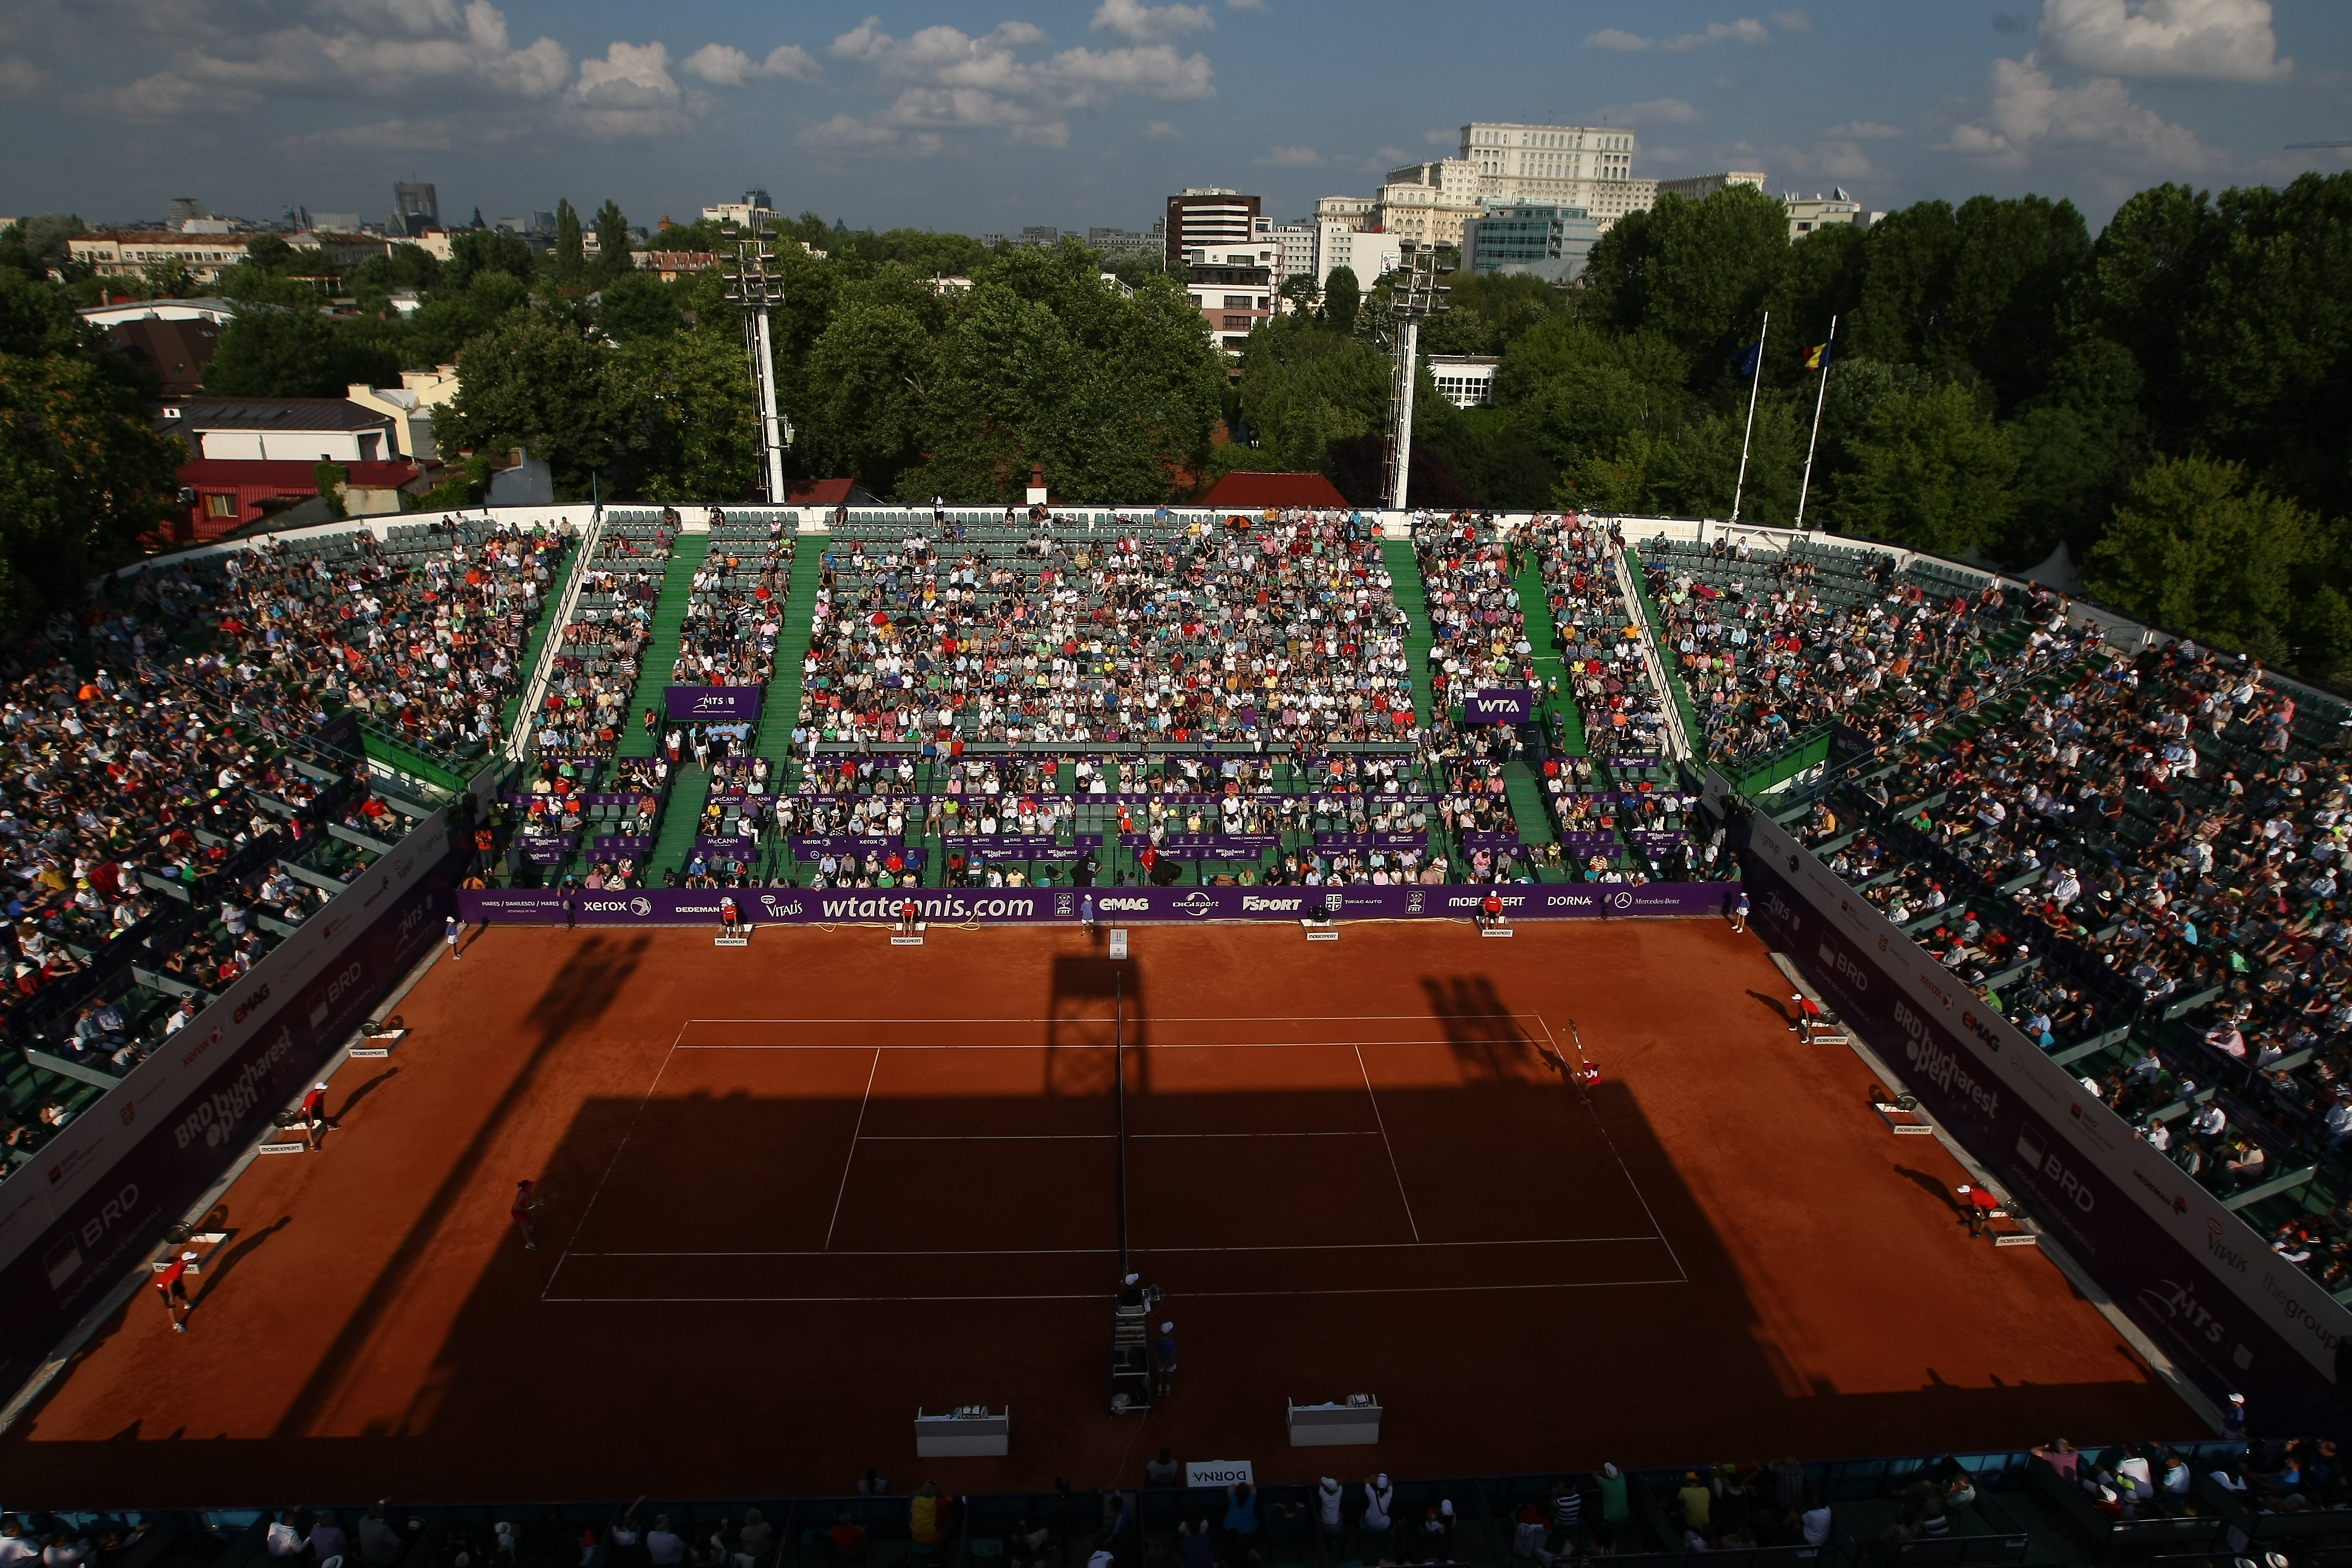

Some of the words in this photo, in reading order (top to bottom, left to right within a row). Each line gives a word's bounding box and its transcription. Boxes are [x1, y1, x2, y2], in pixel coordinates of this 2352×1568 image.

[1477, 699, 1520, 712] WTA
[584, 901, 627, 911] xerox
[1099, 898, 1149, 911] eMAG
[1250, 899, 1302, 911] SPORT
[1548, 897, 1593, 906] DORNA
[328, 962, 361, 1003] BRD
[1837, 952, 1868, 991] BRD
[1919, 974, 1942, 998] xerox
[233, 983, 270, 1024] eMAG
[1962, 1011, 2001, 1053] eMAG
[182, 1039, 210, 1068] xerox
[1894, 1000, 1922, 1039] BRD
[1921, 1026, 1999, 1119] bucharest
[174, 1102, 212, 1149] BRD
[212, 1025, 293, 1117] bucharest
[2045, 1153, 2094, 1212] BRD
[2133, 1169, 2171, 1207] DEDEMAN
[81, 1183, 139, 1249] BRD
[2061, 1216, 2097, 1256] GENERALE
[2171, 1288, 2226, 1343] MTS
[1192, 1471, 1246, 1482] DORNA
